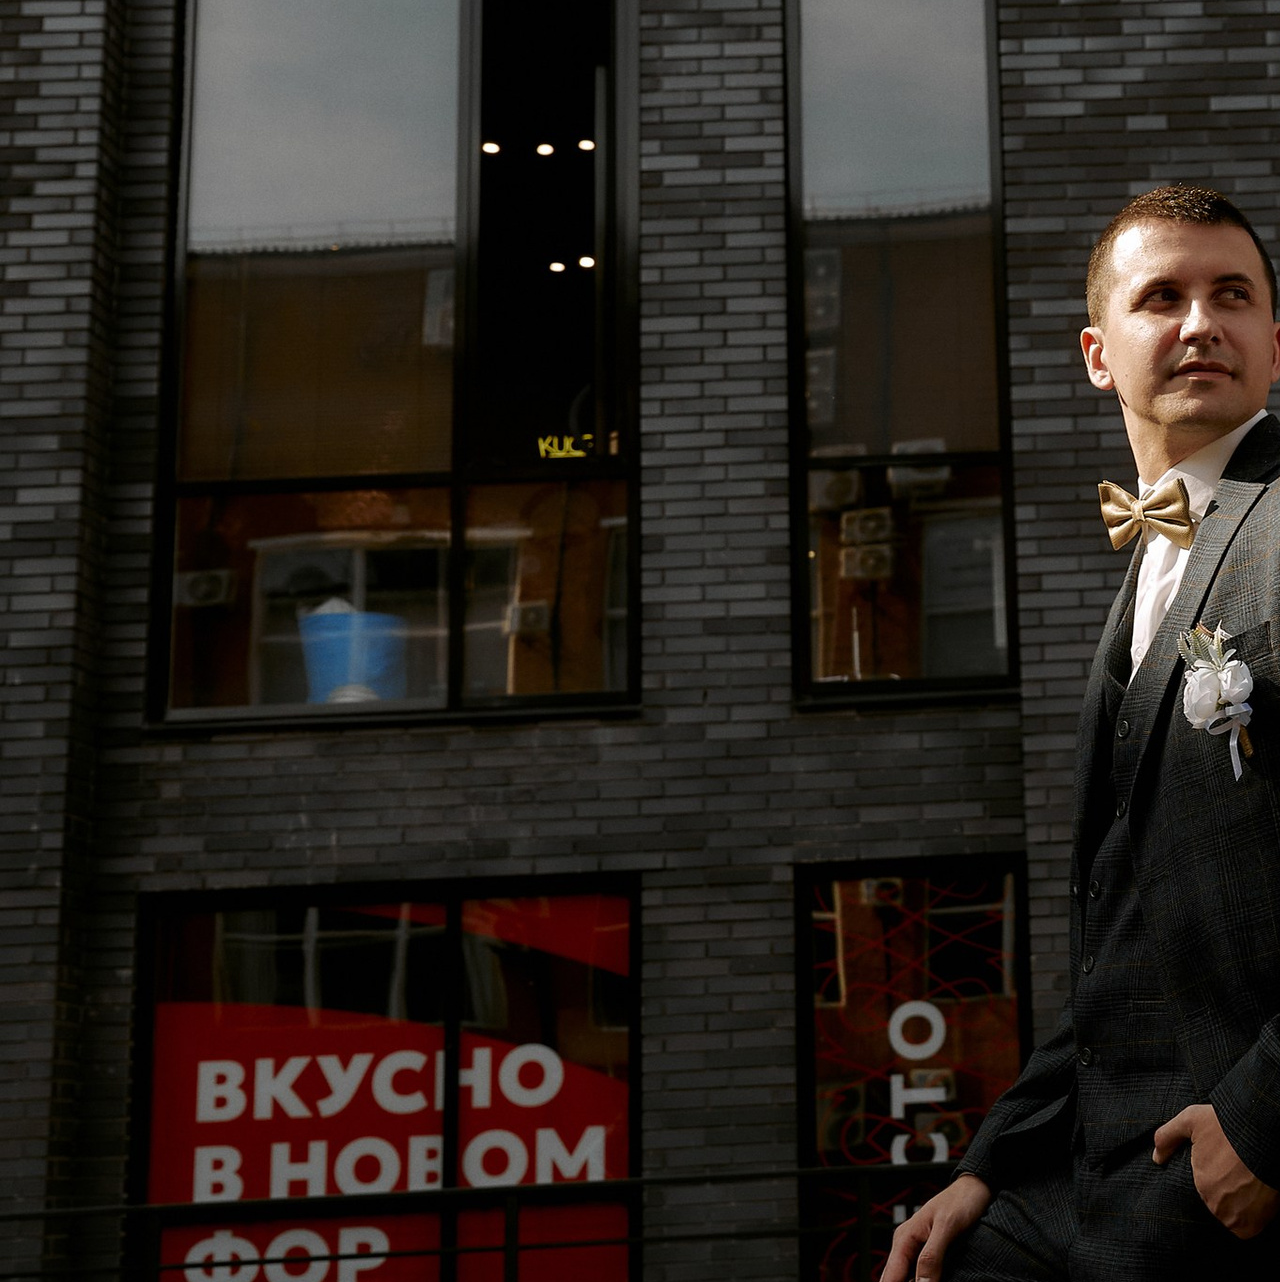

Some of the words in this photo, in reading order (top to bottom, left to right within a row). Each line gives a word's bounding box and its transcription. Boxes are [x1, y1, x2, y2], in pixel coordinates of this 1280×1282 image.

[194, 1042, 566, 1125] ВКУСНО
[887, 999, 950, 1225] СТО
[191, 1143, 246, 1205] В
[267, 1124, 606, 1202] НОВОМ
